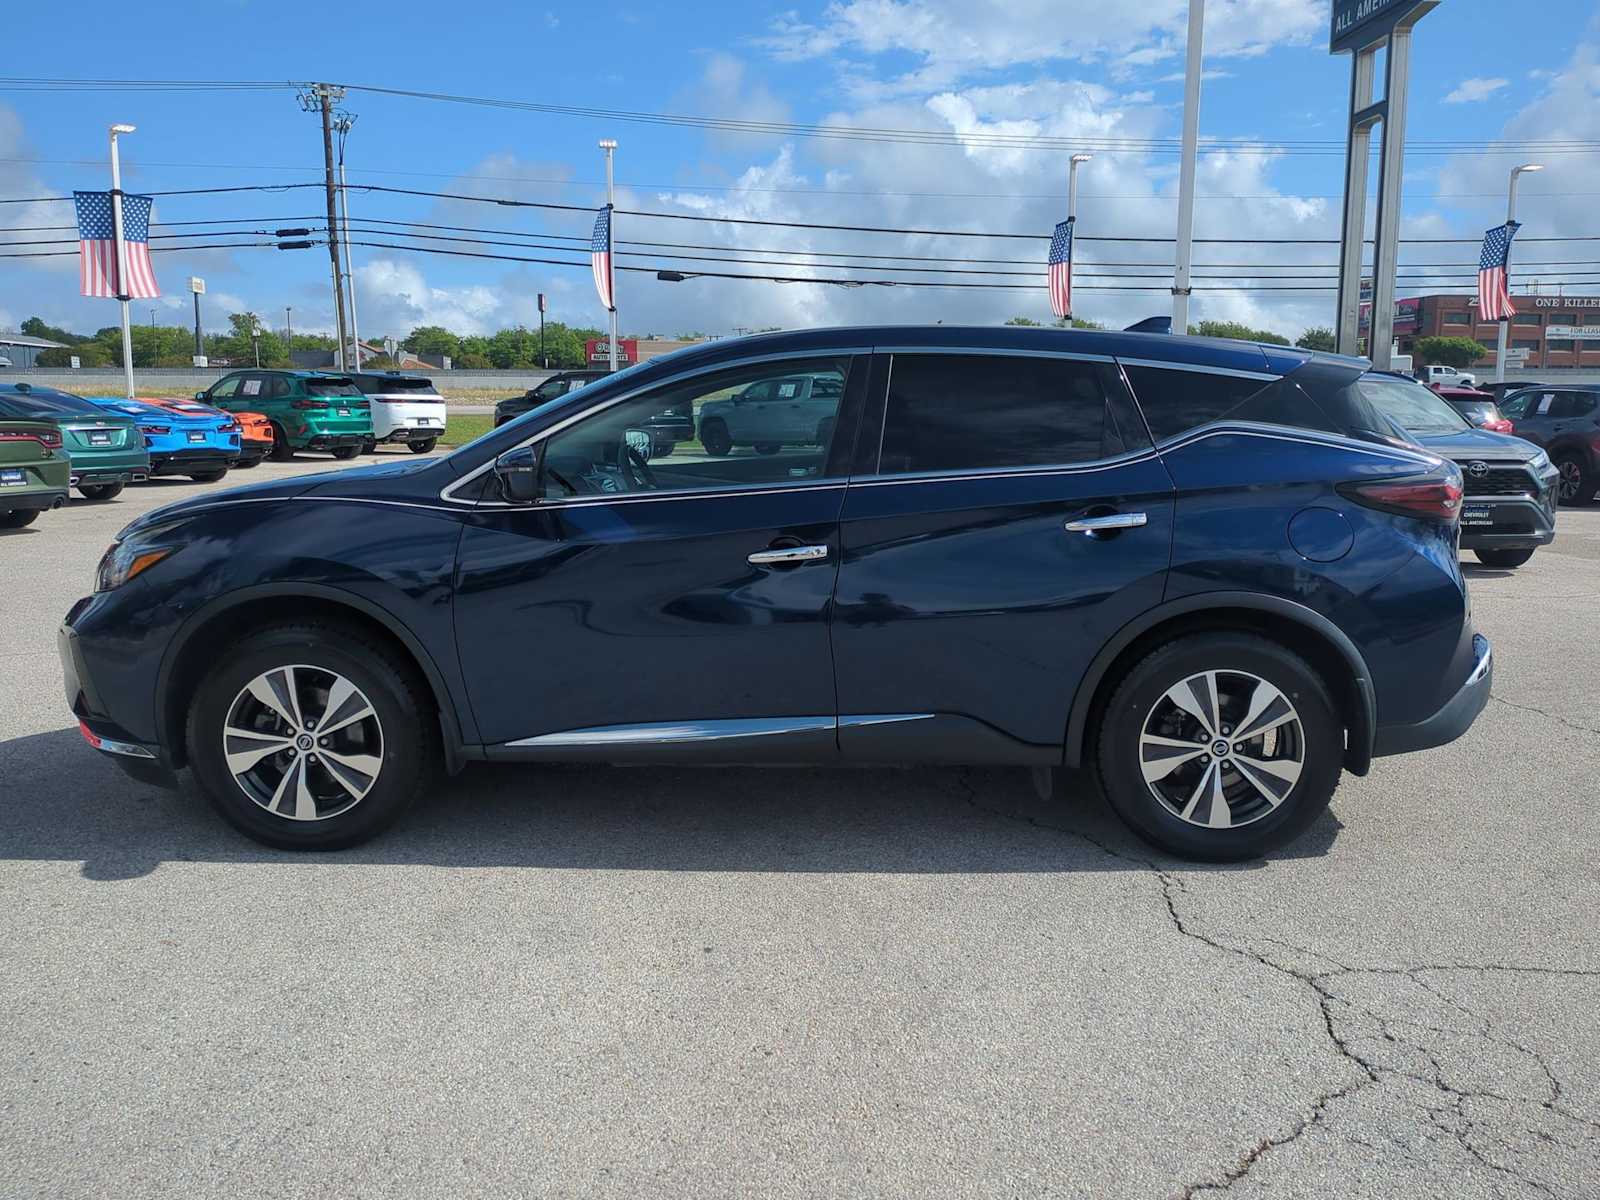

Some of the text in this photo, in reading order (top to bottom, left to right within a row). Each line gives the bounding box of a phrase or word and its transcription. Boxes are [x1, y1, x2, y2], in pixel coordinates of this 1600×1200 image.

[1335, 9, 1353, 33] ALL
[1535, 298, 1600, 308] ONE KILLE
